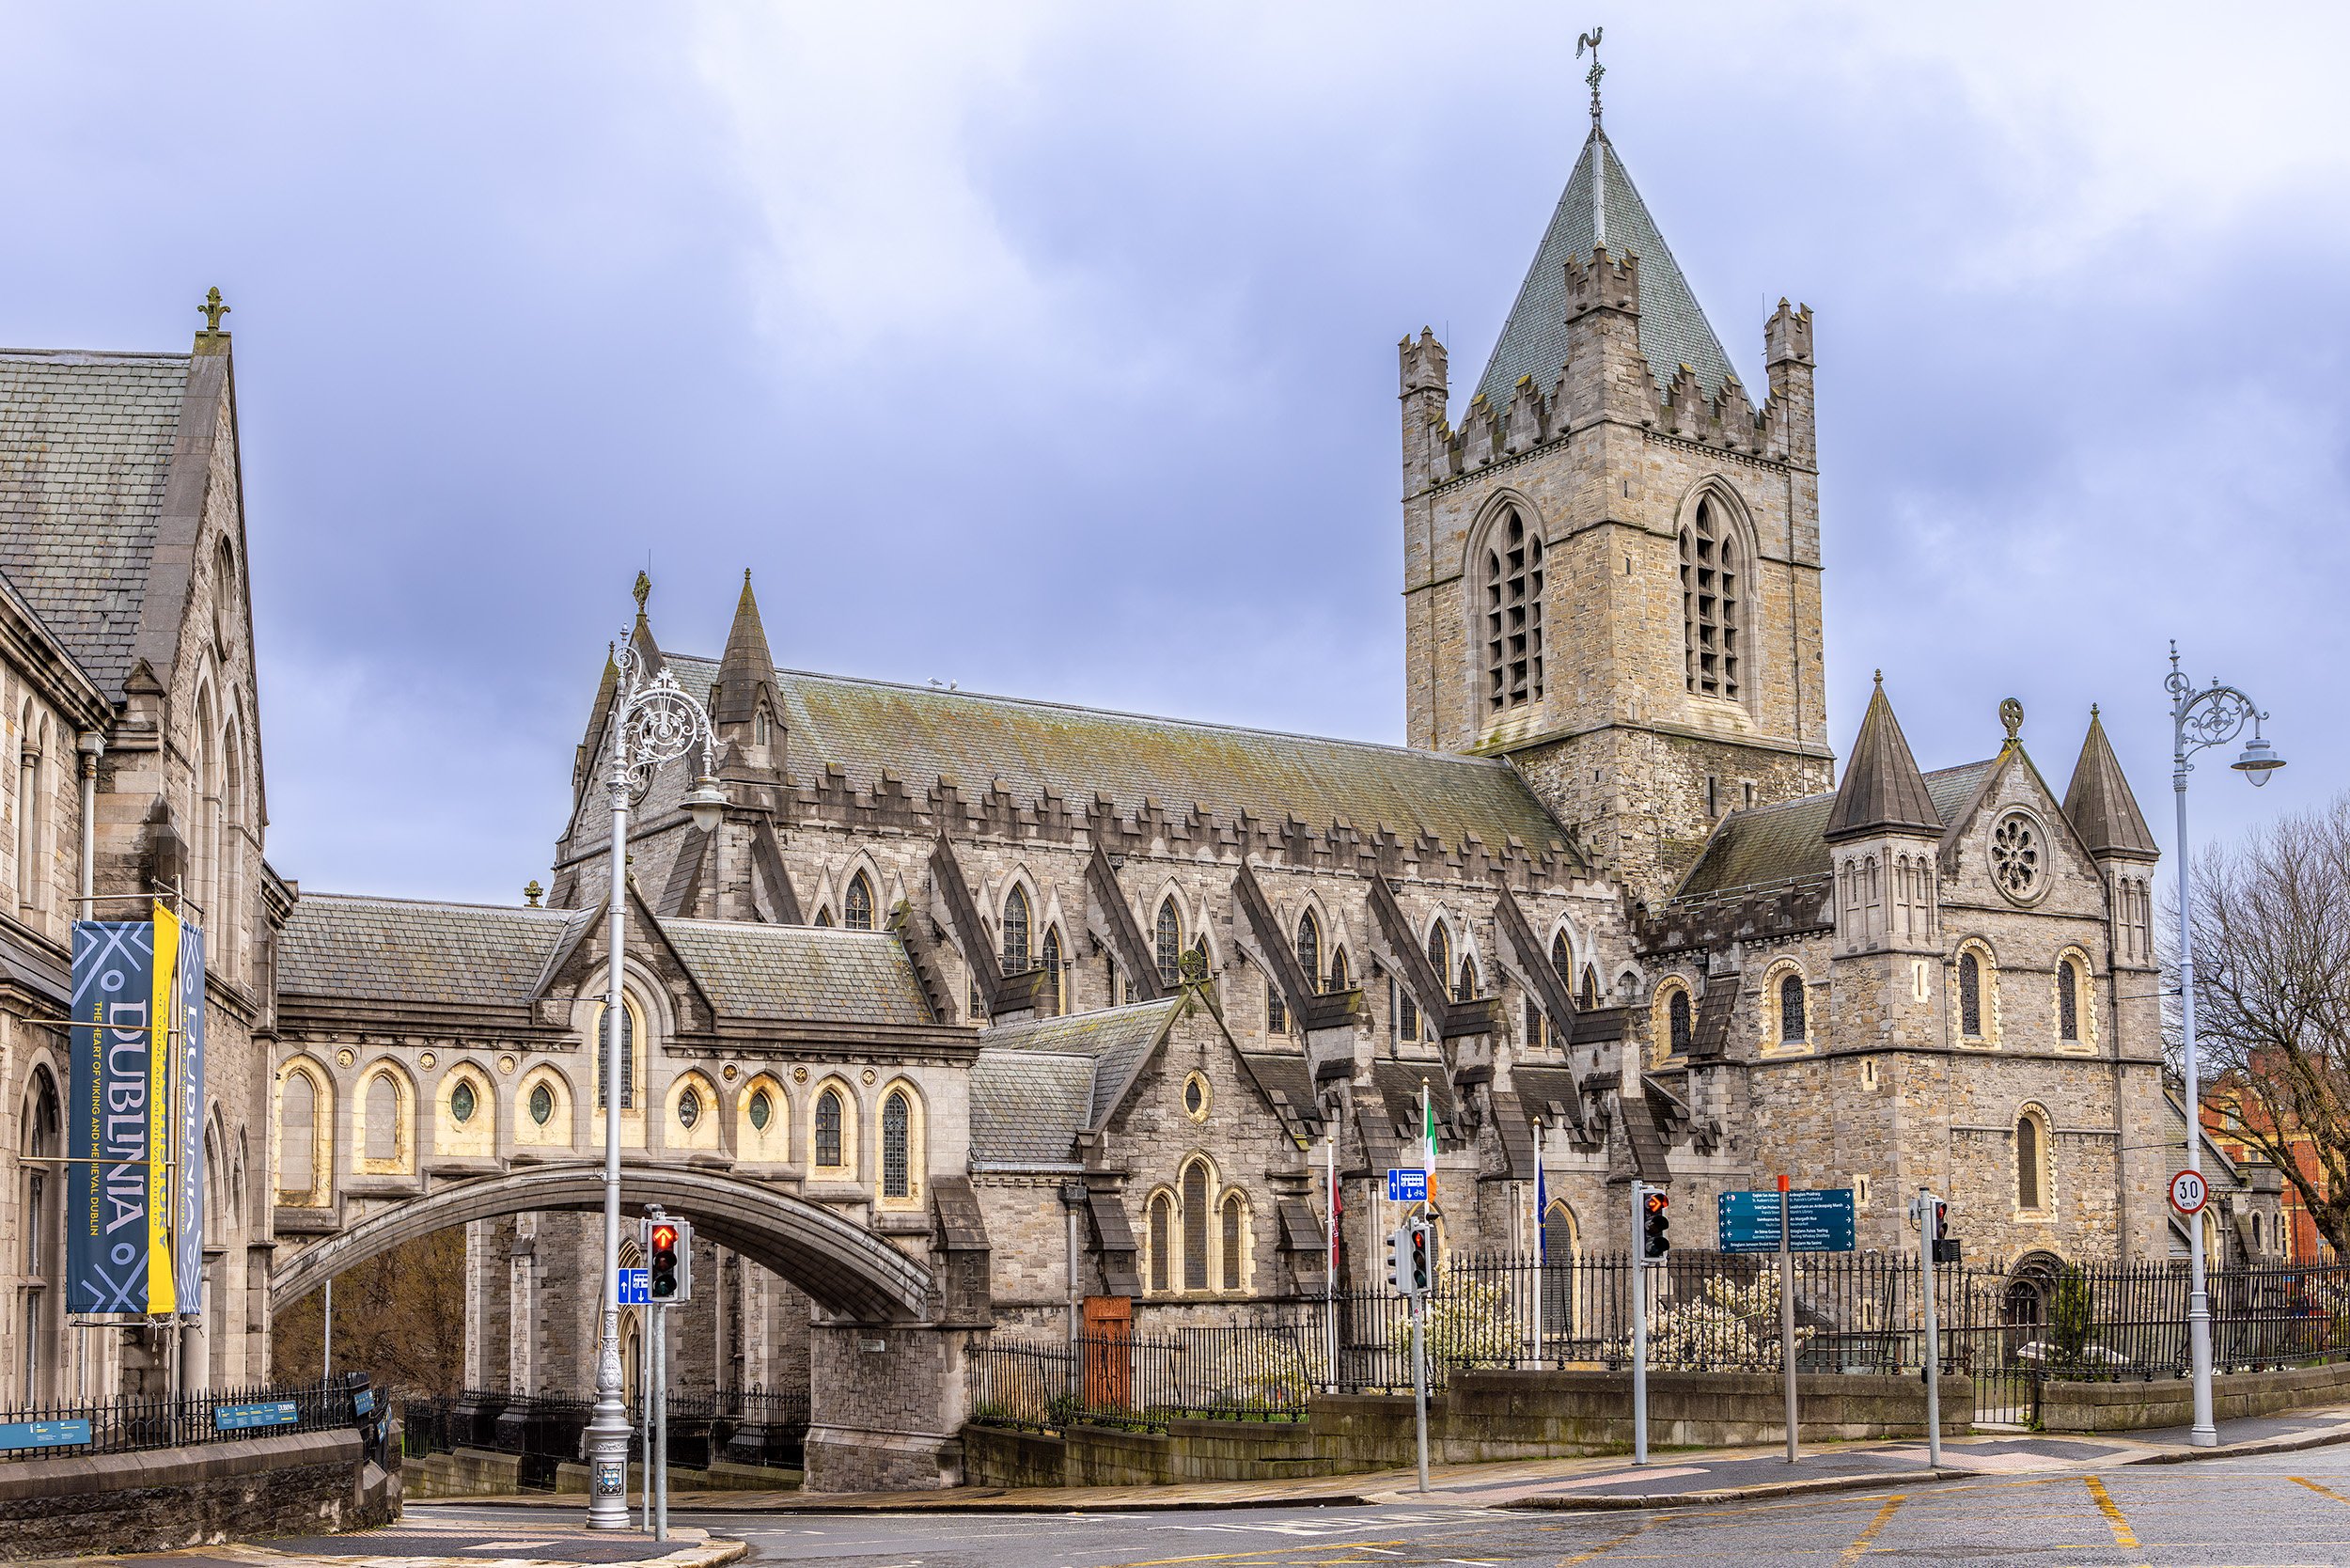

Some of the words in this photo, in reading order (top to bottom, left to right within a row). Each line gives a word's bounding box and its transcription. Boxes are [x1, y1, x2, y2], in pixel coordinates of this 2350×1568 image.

[93, 1001, 102, 1022] THE
[92, 1026, 102, 1059] HEART
[92, 1061, 102, 1076] OF
[92, 1078, 101, 1115] VIKING
[91, 1117, 100, 1140] AND
[106, 998, 147, 1235] DUBLINIA
[2179, 1181, 2199, 1200] 30
[90, 1197, 99, 1236] DUBLIN
